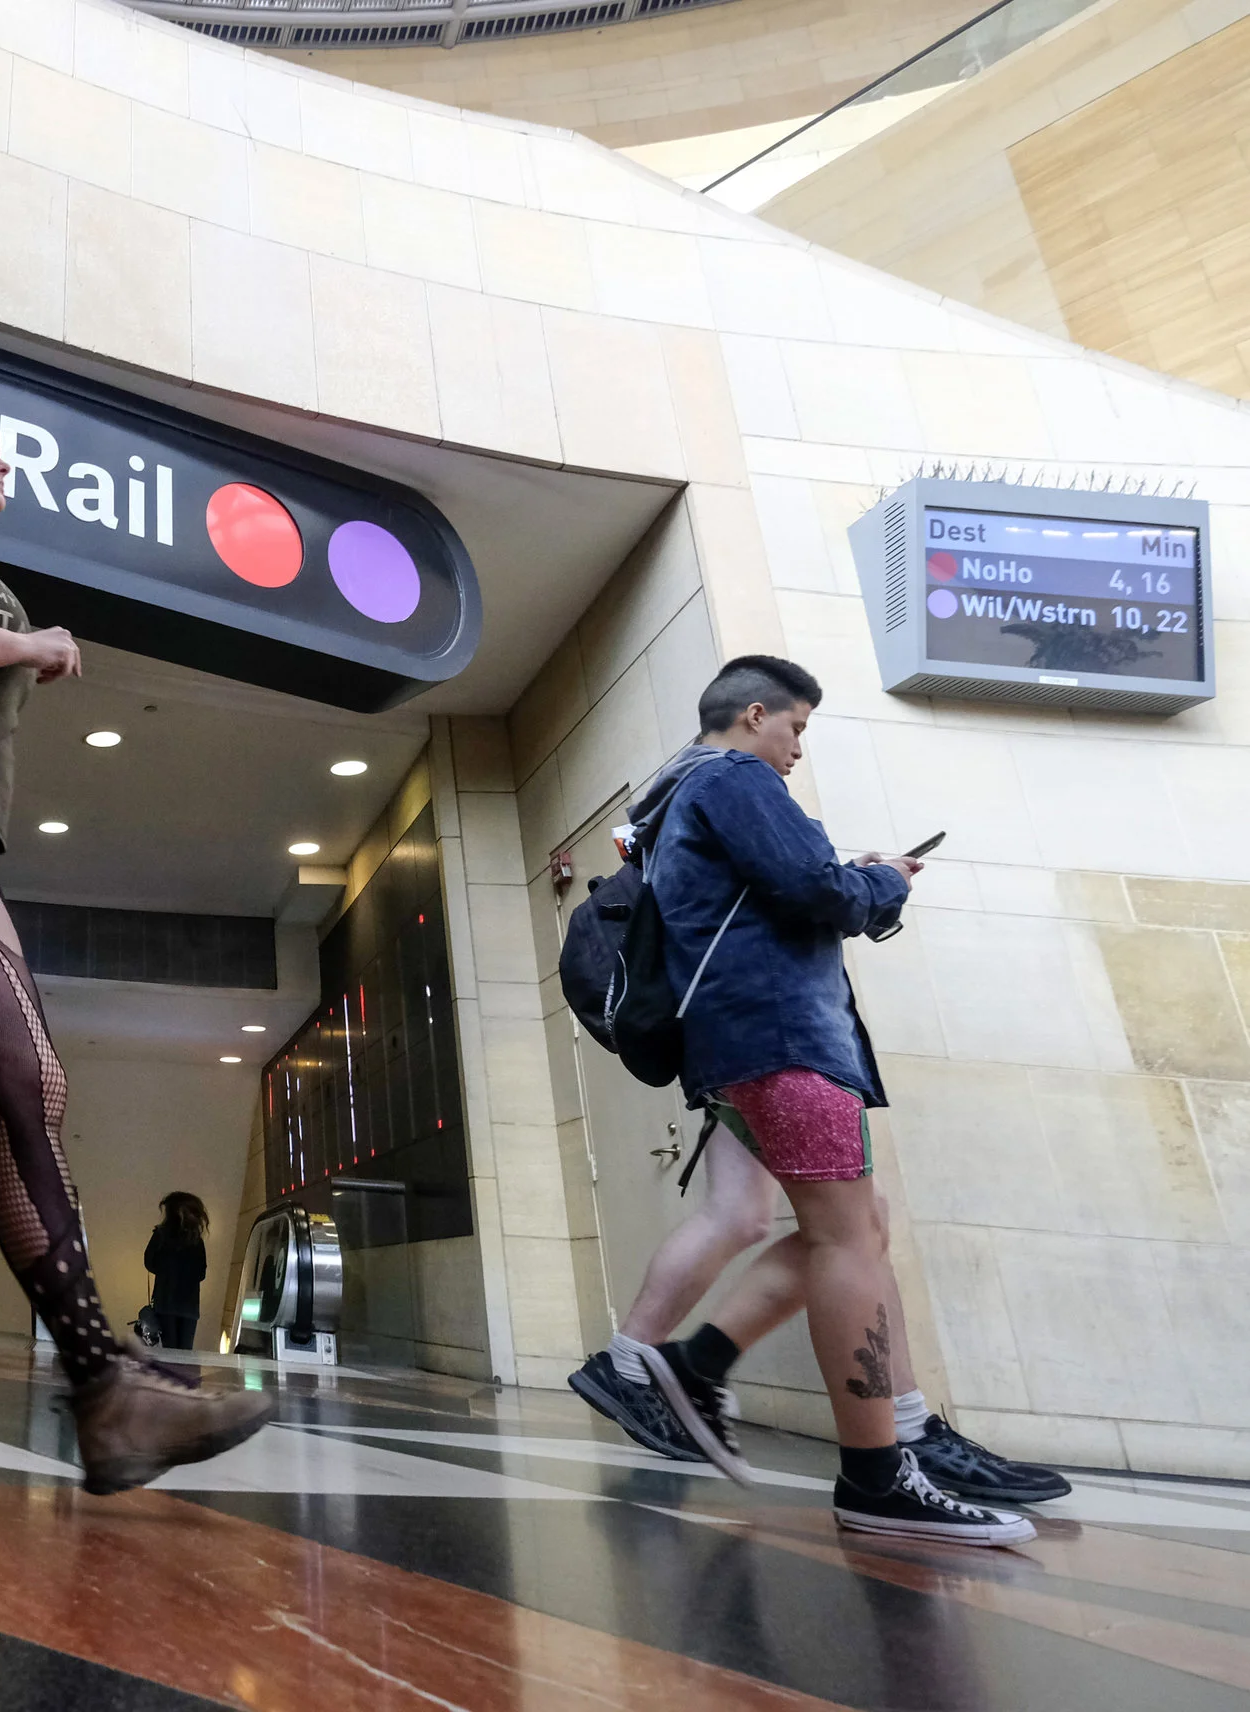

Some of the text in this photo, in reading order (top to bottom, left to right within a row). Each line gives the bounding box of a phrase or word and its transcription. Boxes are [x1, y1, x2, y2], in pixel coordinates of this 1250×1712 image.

[0, 414, 173, 546] Rail
[930, 518, 1186, 559] Dest Min
[963, 557, 1171, 596] NoHo 4, 16
[961, 594, 1096, 626] Wil/Wstrn
[1156, 610, 1188, 633] 22
